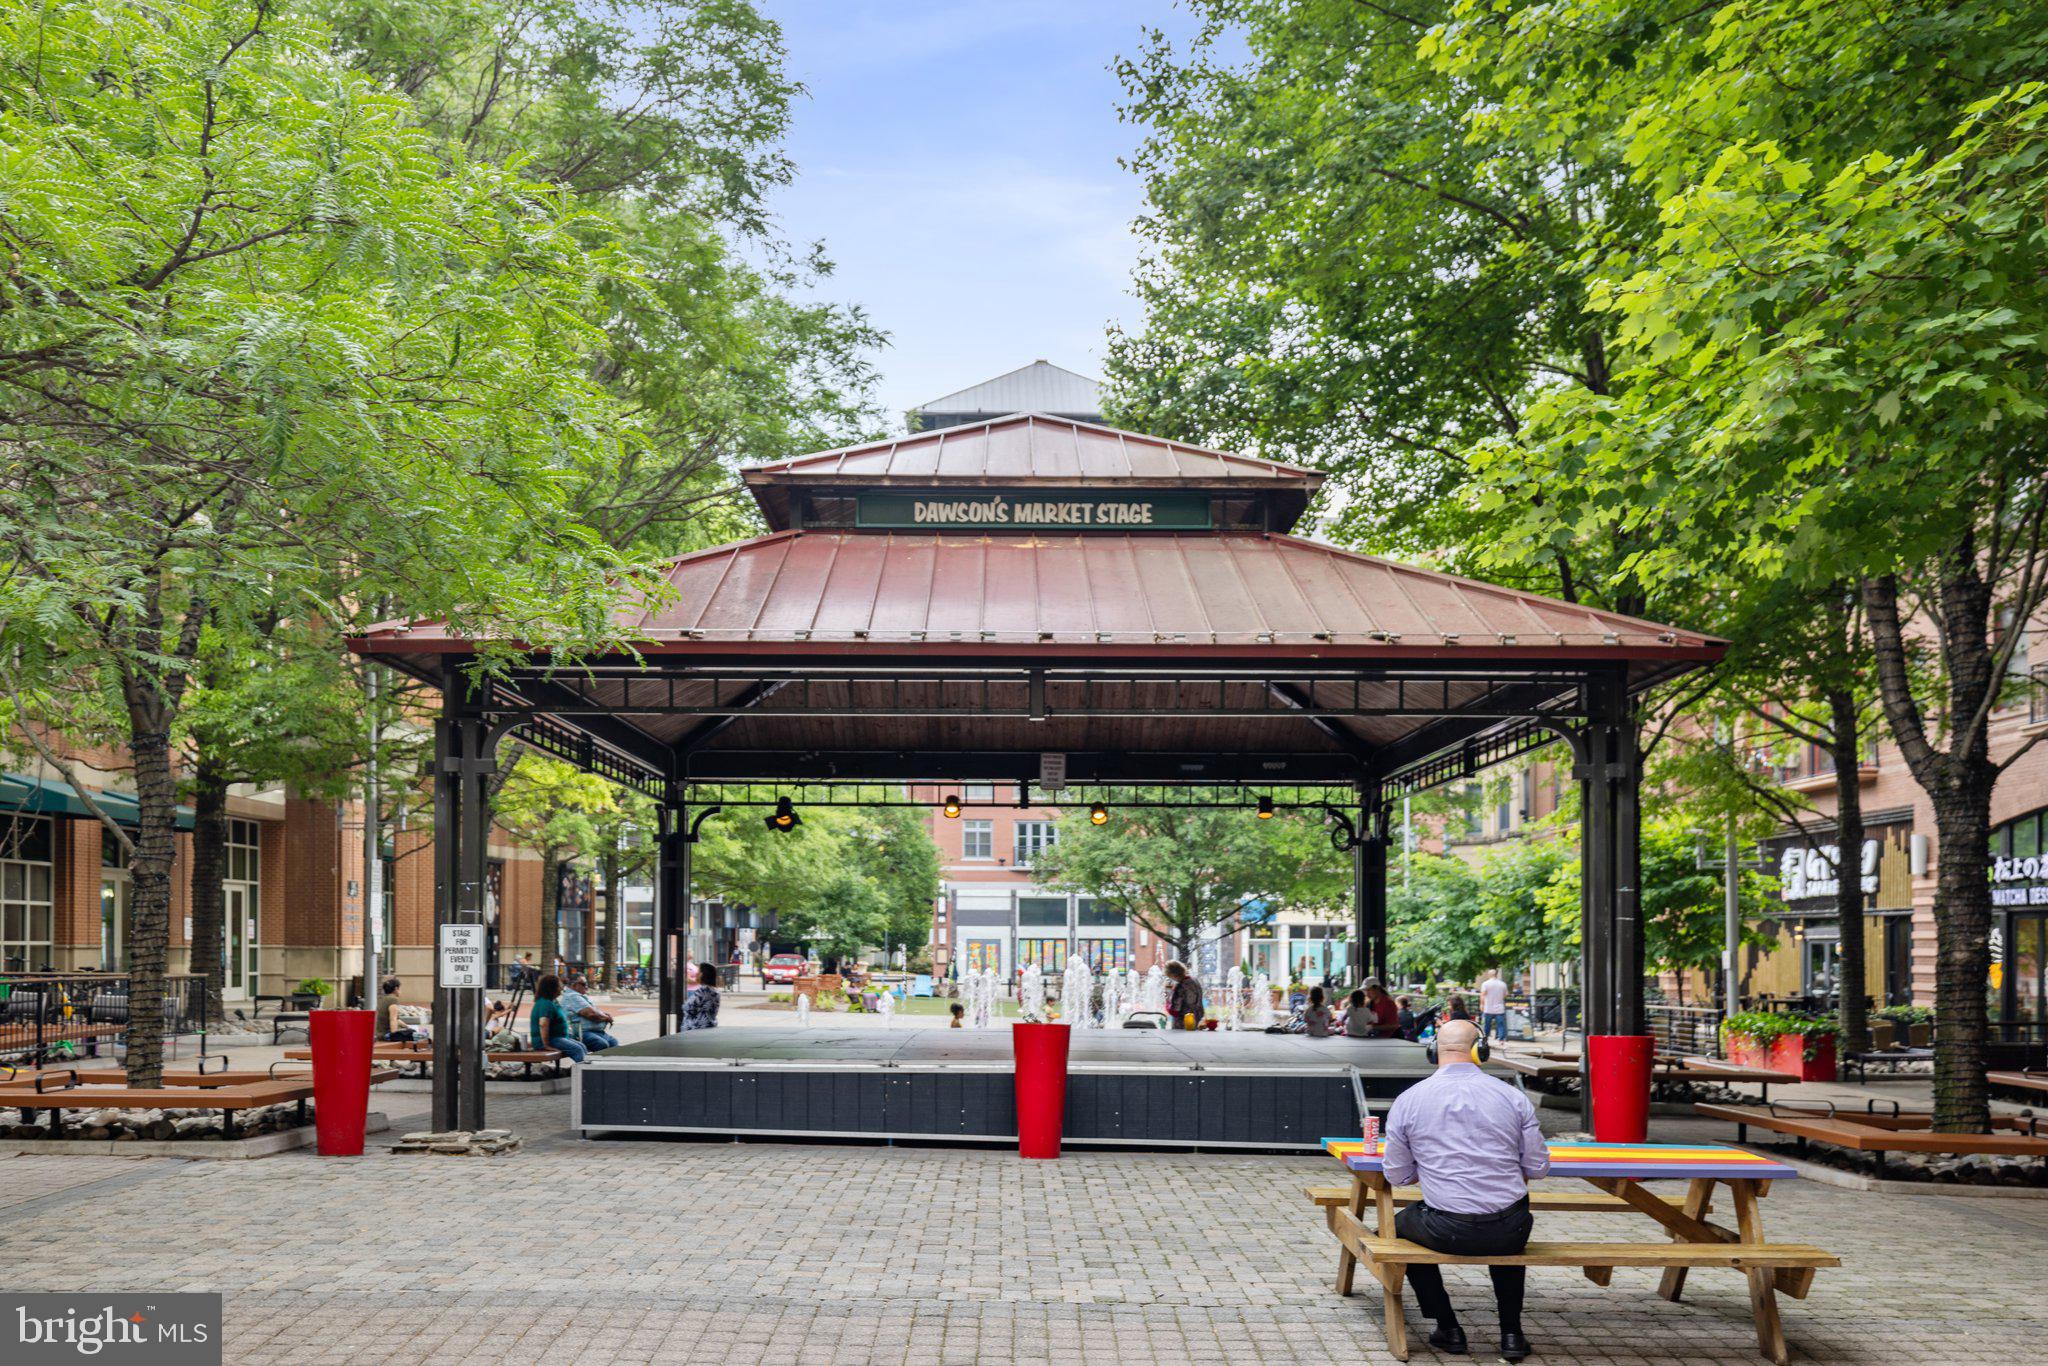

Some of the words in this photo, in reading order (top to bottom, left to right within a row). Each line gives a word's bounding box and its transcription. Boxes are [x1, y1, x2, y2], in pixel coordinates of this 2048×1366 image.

[914, 495, 1009, 523] DAWSON'S
[1014, 503, 1094, 524] MARKET
[1096, 503, 1153, 524] STAGE
[1992, 888, 2028, 906] MATCHA
[452, 929, 471, 937] STAGE
[455, 938, 468, 946] FOR
[444, 947, 480, 955] PERMITTED
[450, 955, 474, 963] EVENTS
[454, 964, 469, 972] ONLY
